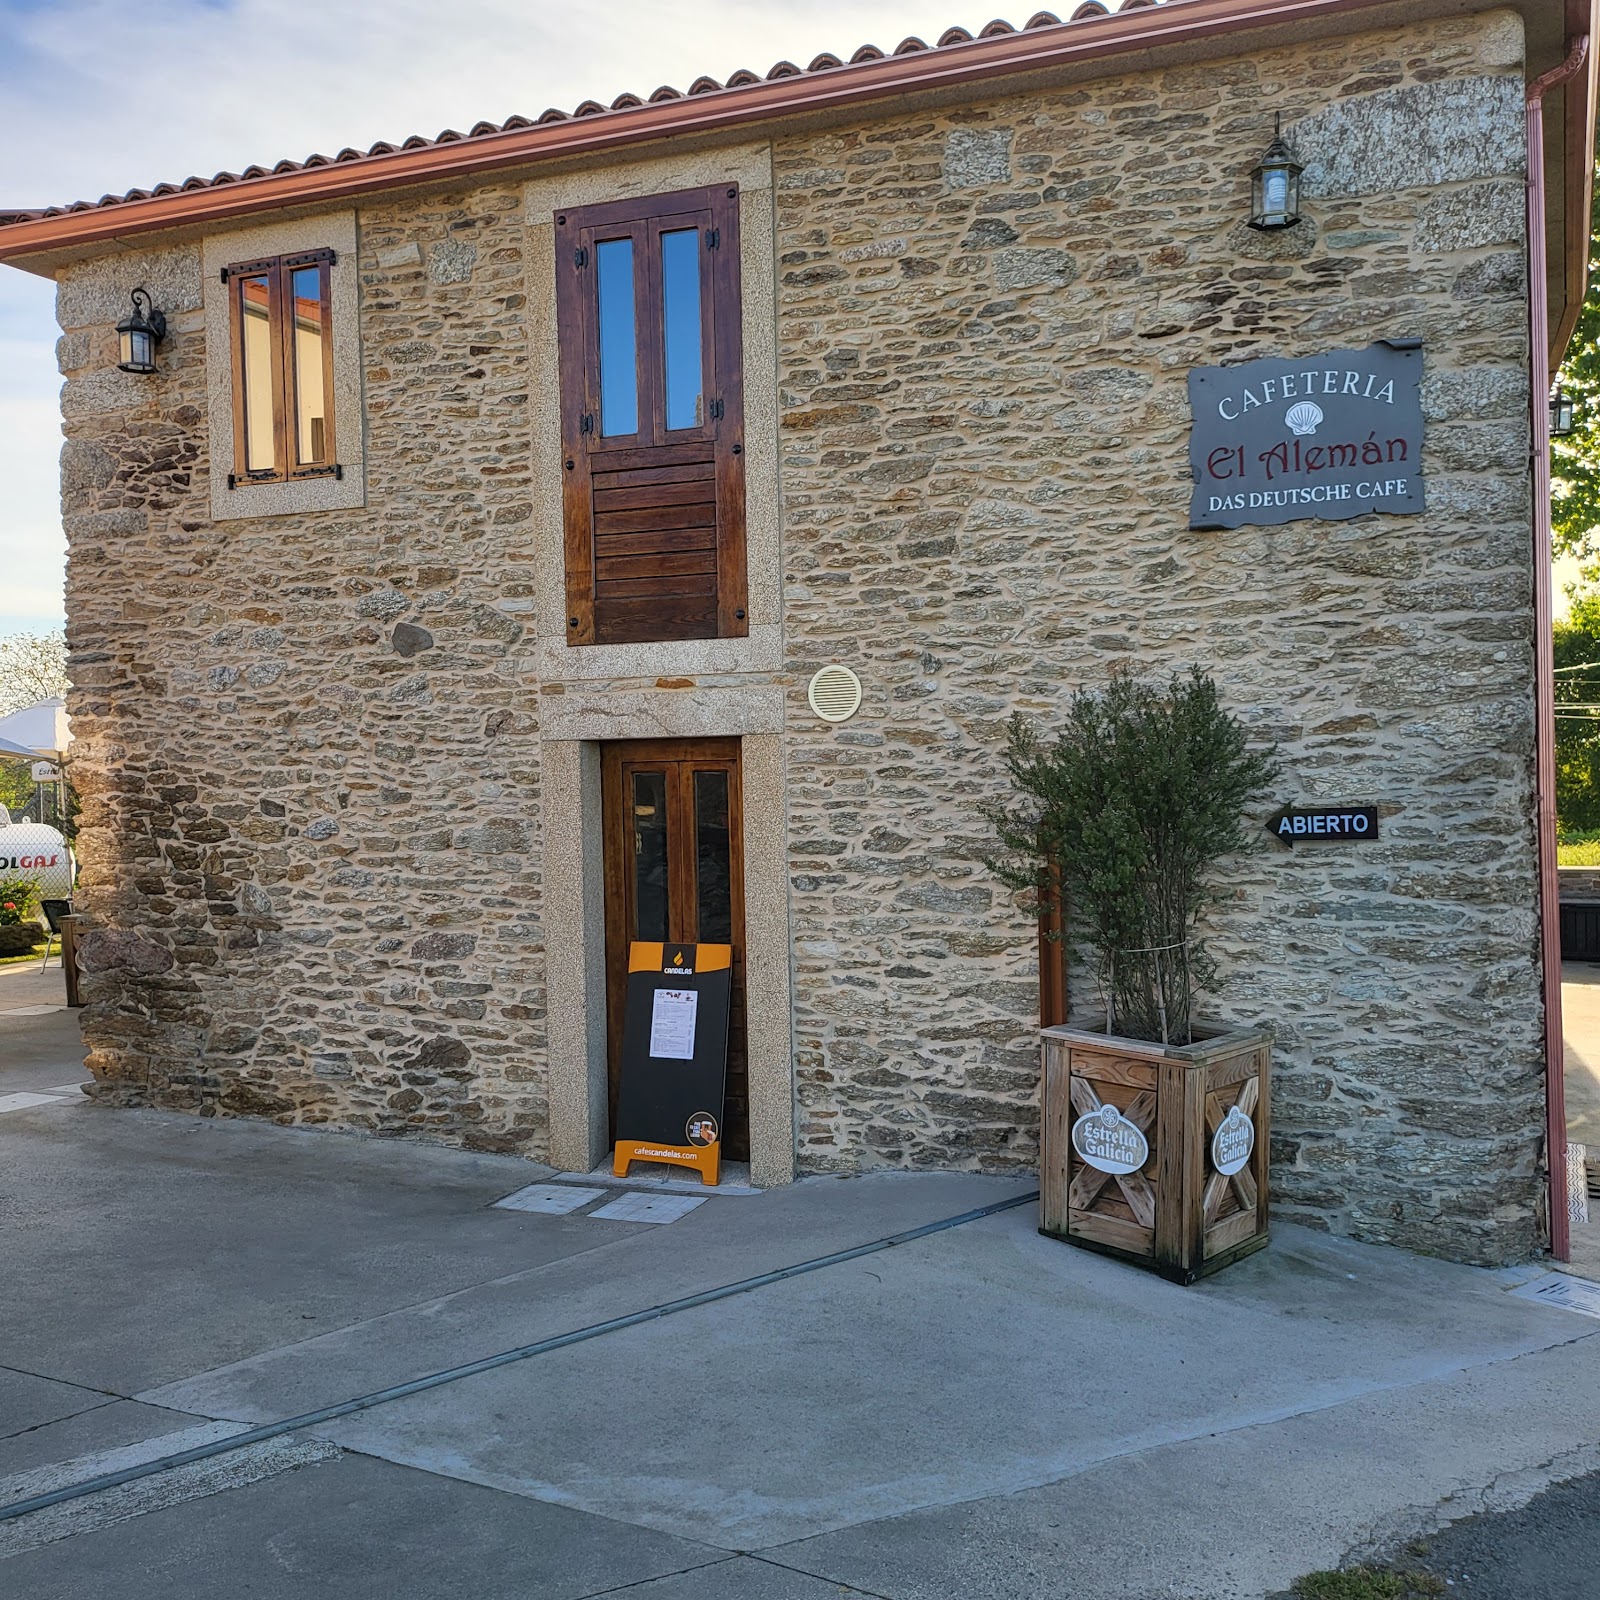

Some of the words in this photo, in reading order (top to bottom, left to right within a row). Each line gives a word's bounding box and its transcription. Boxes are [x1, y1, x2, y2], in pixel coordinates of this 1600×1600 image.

[1218, 370, 1395, 420] CAFETERIA
[1207, 444, 1245, 480] El
[1258, 431, 1408, 480] Alemán
[1208, 493, 1245, 512] DAS
[1248, 484, 1352, 508] DEUTSCHE
[1355, 478, 1408, 498] CAFE
[1278, 814, 1369, 834] ABIERTO
[664, 967, 693, 975] CANDELAS
[1082, 1121, 1138, 1148] Estrella
[1219, 1125, 1249, 1148] Estrella
[634, 1146, 698, 1160] cafescandelas.com
[1085, 1138, 1135, 1164] Galicia
[1220, 1143, 1248, 1164] Galicia
